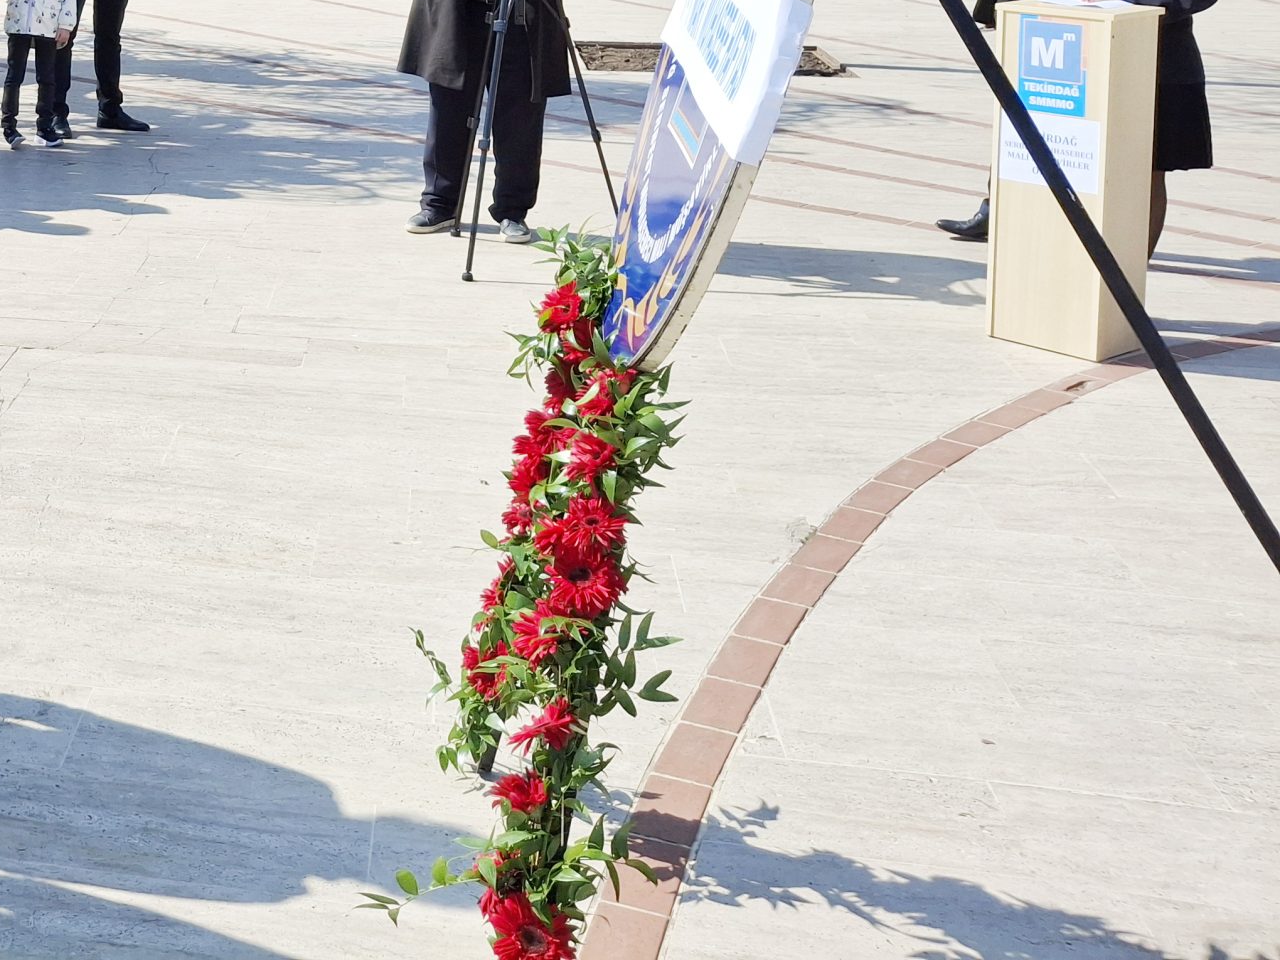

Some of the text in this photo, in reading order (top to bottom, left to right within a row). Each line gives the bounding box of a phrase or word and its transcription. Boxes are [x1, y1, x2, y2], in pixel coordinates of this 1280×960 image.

[1023, 81, 1080, 98] TEKİRDAĞ
[1028, 95, 1075, 110] SMMMO
[1042, 131, 1078, 147] İRDAĞ
